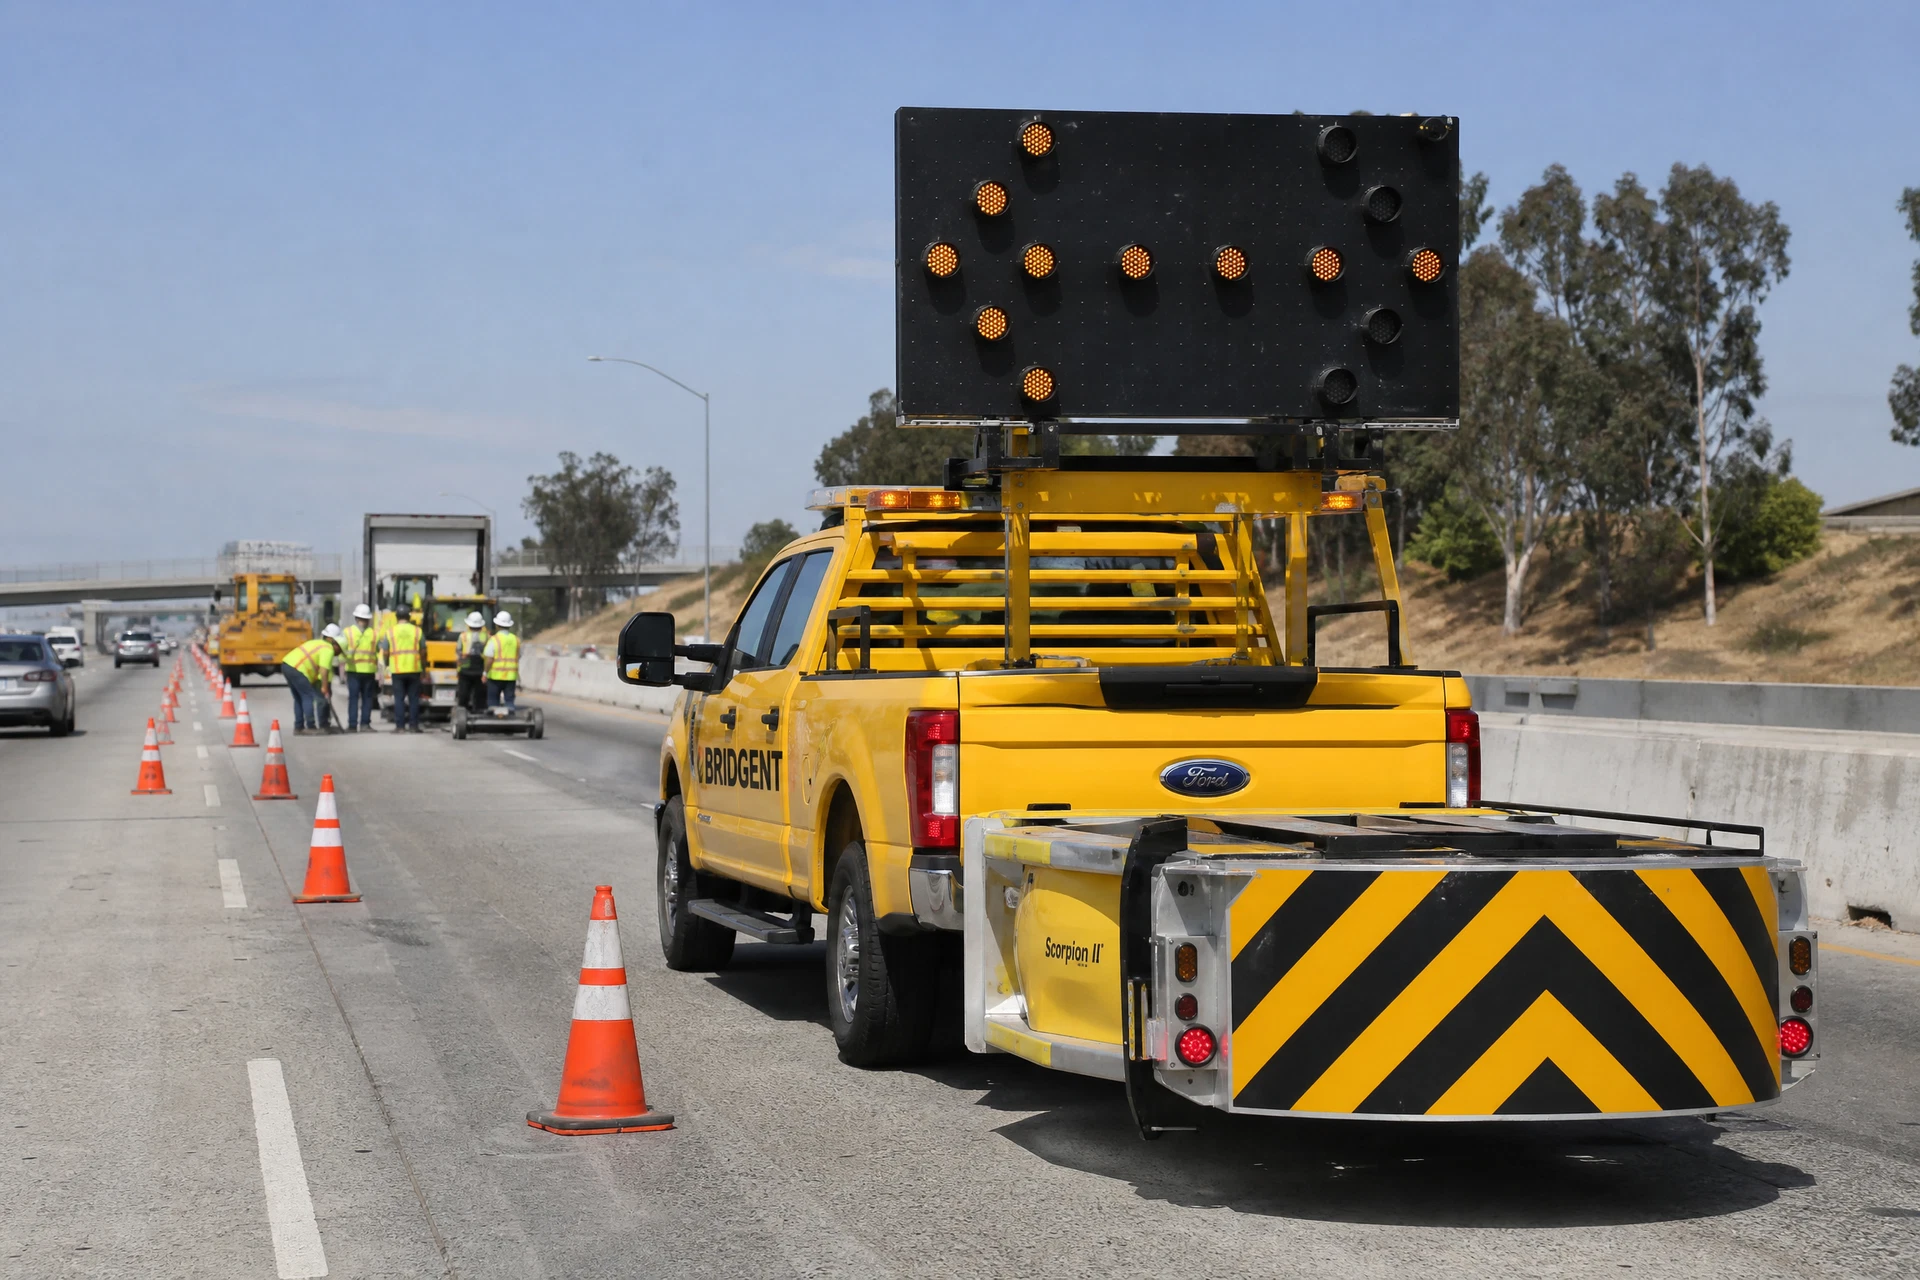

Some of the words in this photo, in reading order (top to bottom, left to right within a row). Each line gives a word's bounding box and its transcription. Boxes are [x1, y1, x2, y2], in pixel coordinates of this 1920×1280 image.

[705, 747, 783, 791] BRIDGENT
[1182, 766, 1229, 787] Ford
[1045, 936, 1089, 965] Scorpion
